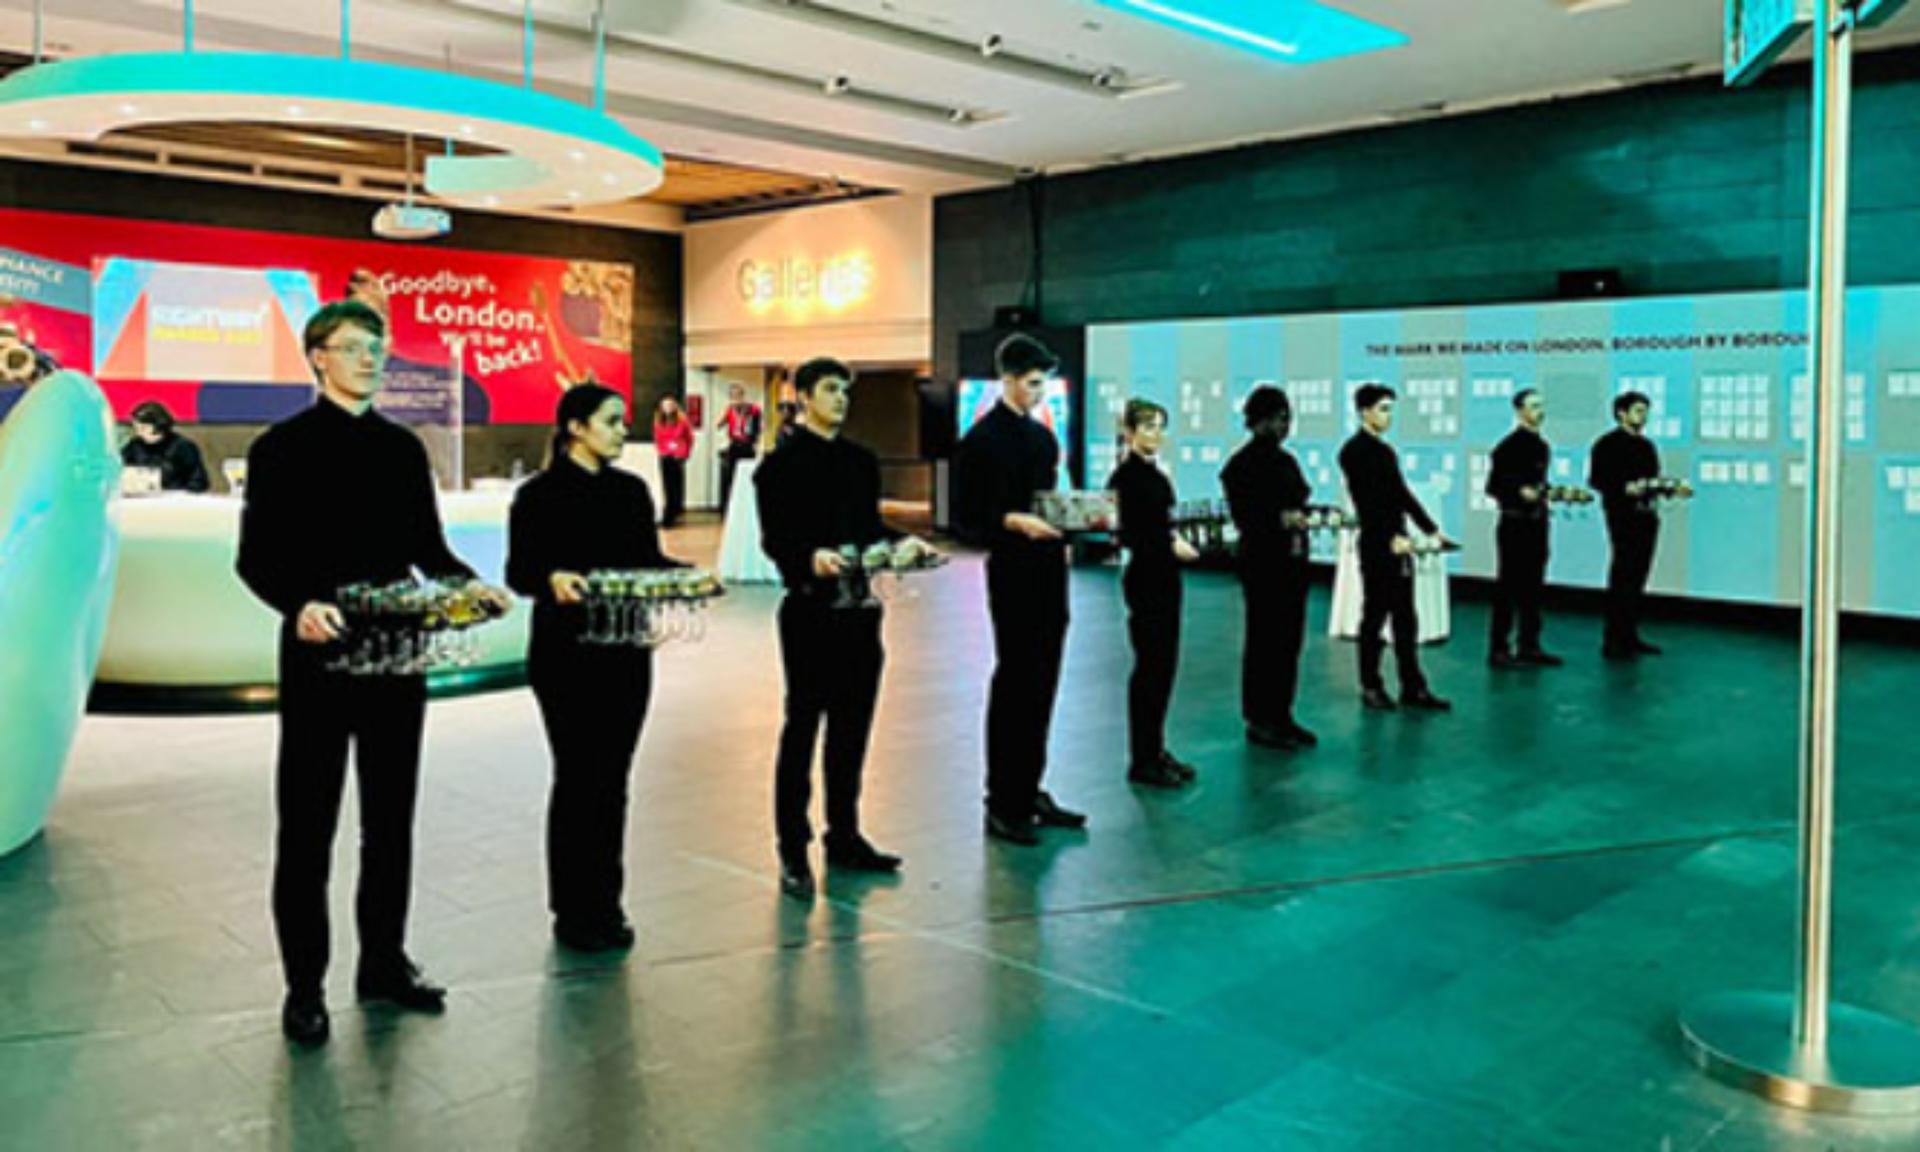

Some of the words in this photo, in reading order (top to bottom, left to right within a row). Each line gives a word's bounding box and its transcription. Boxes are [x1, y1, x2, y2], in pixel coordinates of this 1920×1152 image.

[380, 271, 495, 298] Goodbye,
[416, 296, 544, 331] London.
[475, 339, 541, 375] back!
[1505, 339, 1529, 353] ON
[1612, 335, 1701, 350] BOROUGH
[1706, 334, 1727, 348] BY
[1732, 331, 1810, 348] BOROU
